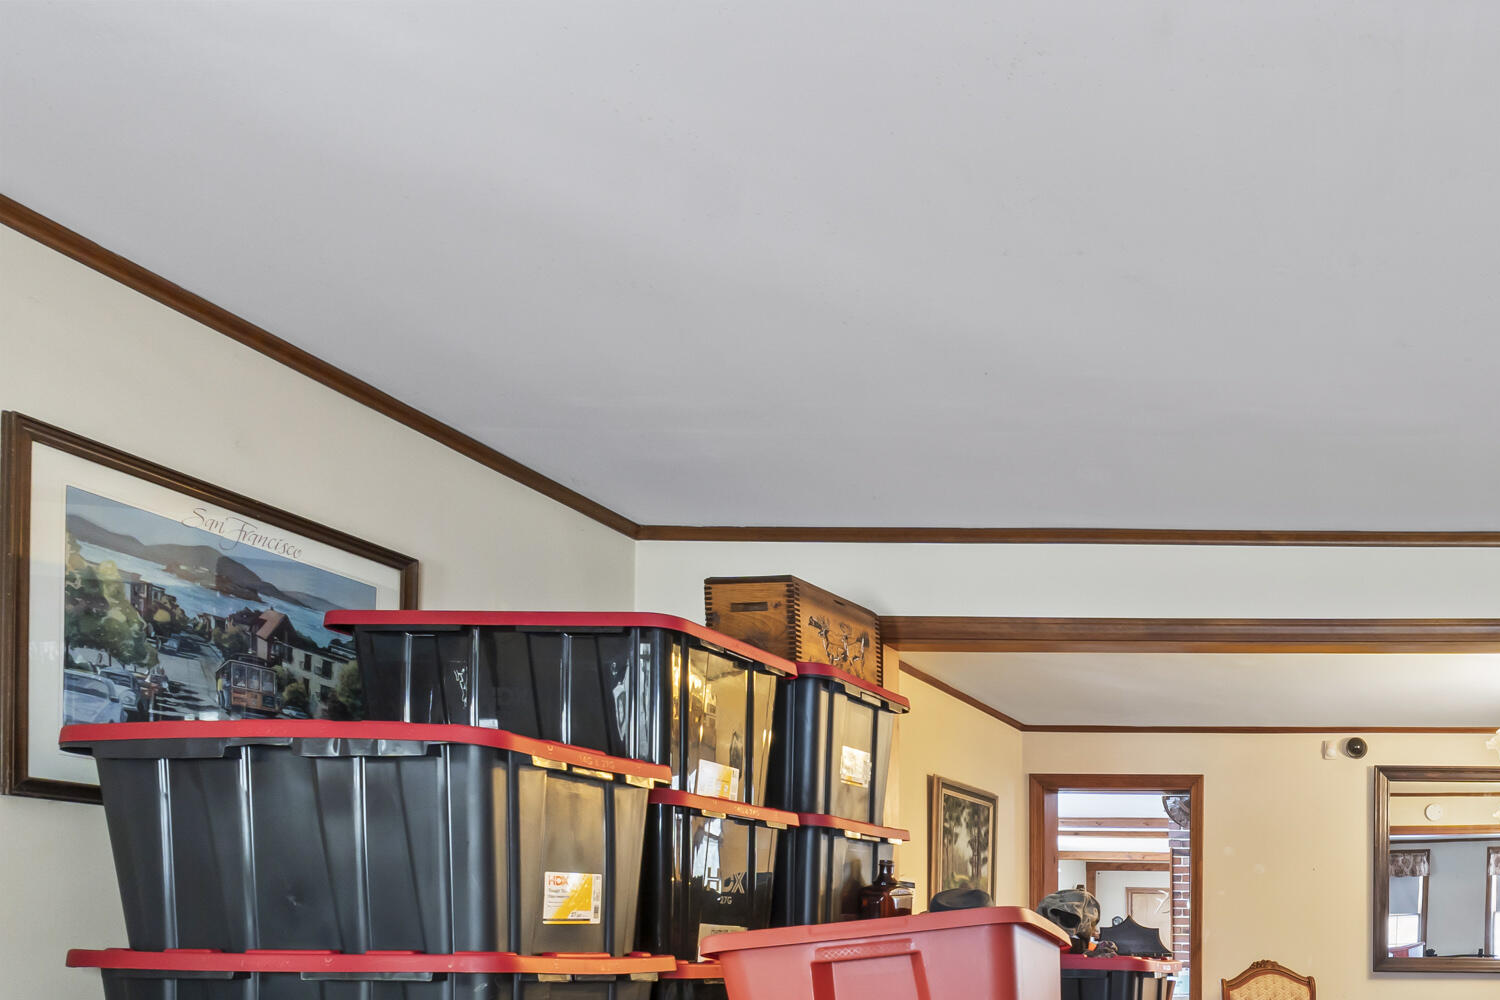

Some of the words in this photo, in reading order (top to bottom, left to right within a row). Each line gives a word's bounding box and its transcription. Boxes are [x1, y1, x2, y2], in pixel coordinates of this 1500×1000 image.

[181, 507, 225, 534] San
[219, 517, 302, 559] Francisco
[548, 875, 568, 886] HDX
[707, 867, 746, 894] HDX
[719, 896, 733, 905] 27G
